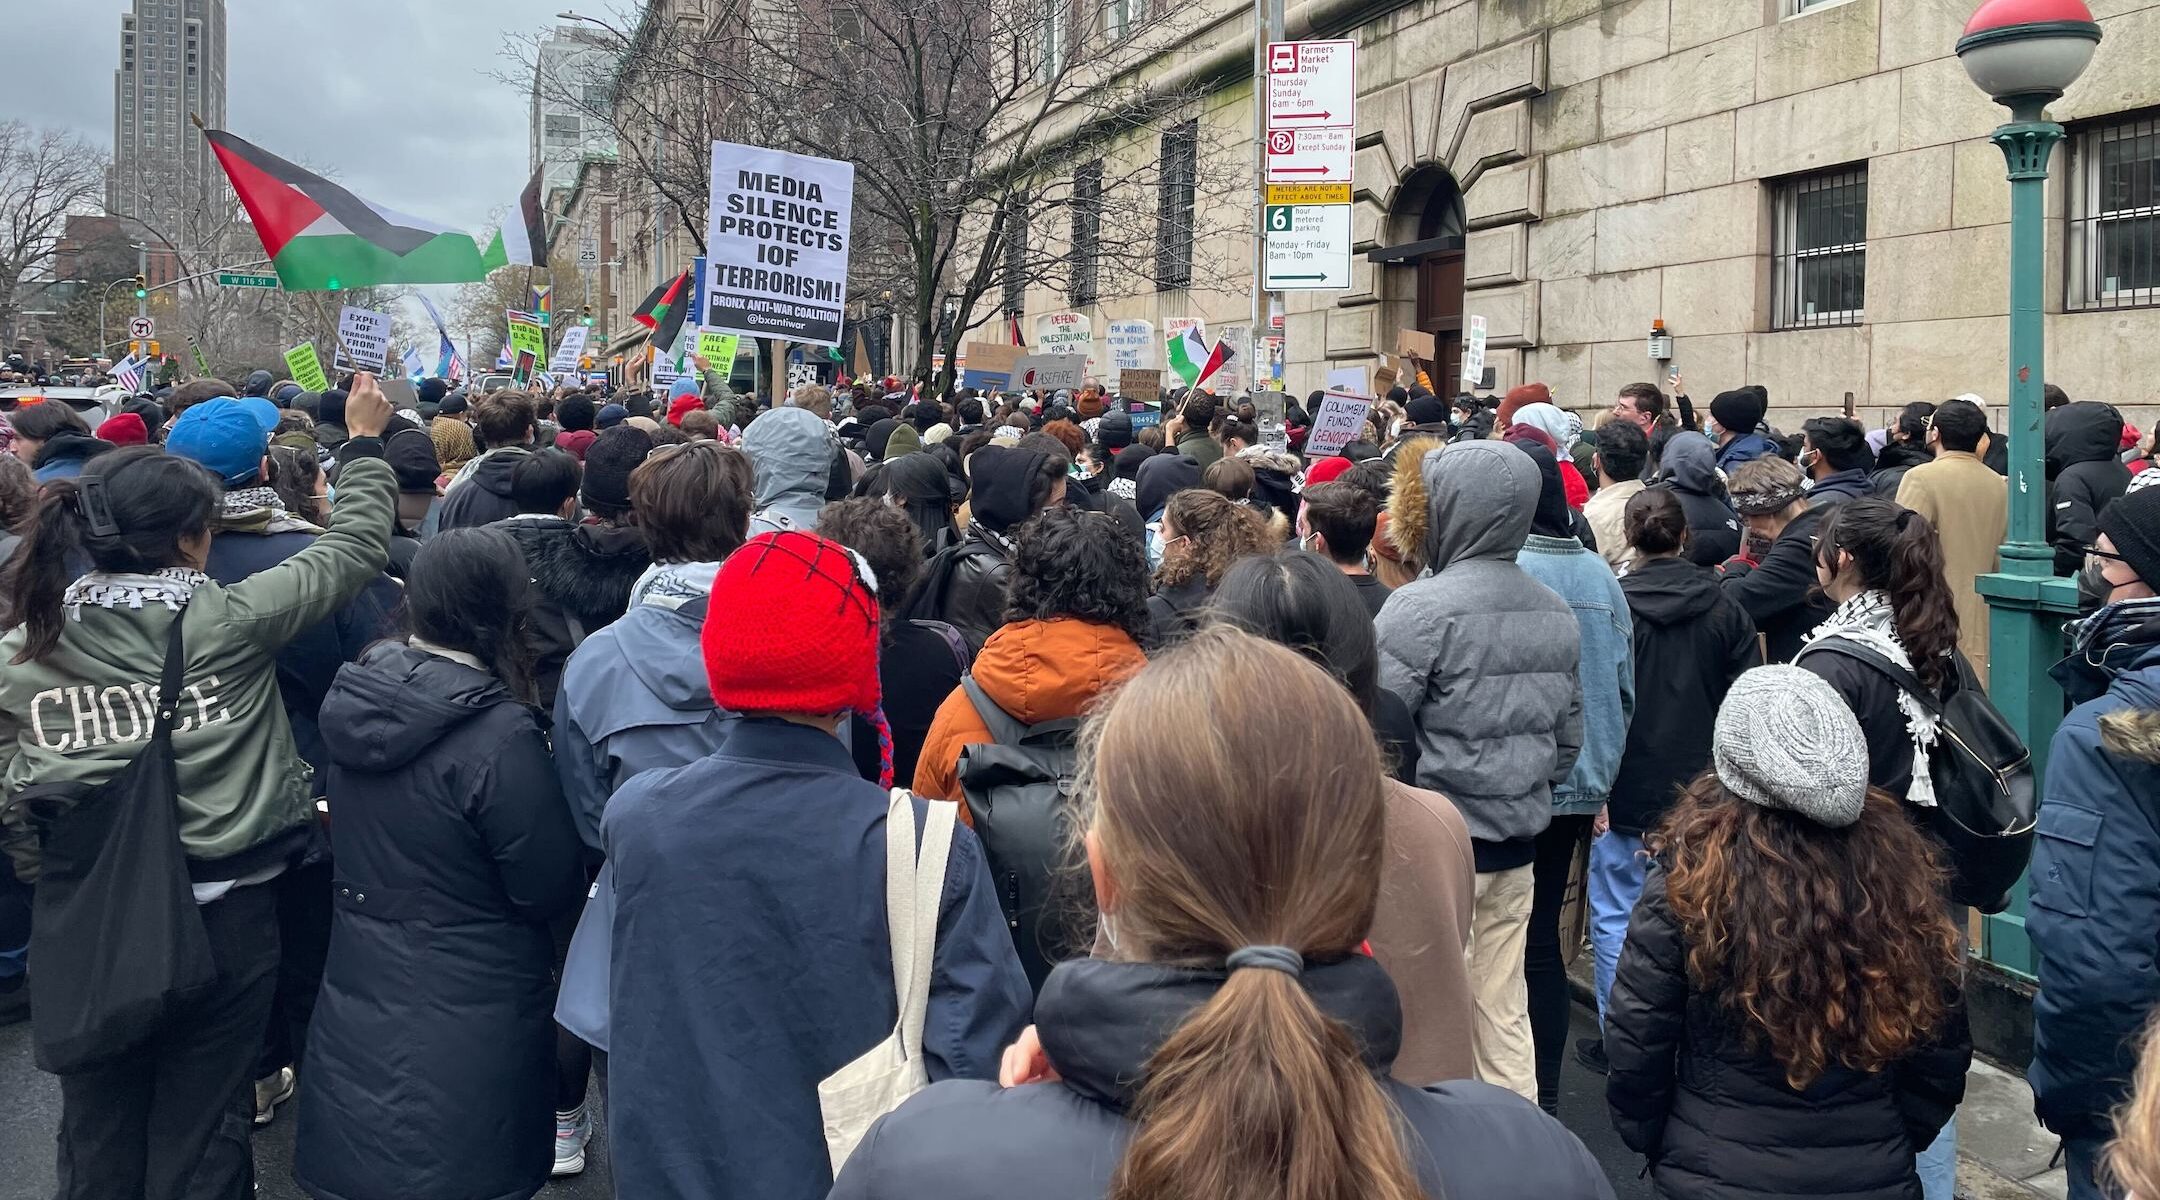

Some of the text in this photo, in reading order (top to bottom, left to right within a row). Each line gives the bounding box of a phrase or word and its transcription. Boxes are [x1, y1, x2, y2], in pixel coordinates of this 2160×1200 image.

[1302, 46, 1334, 54] Farmers
[1302, 55, 1329, 64] Market
[1302, 65, 1319, 74] Only
[1273, 78, 1308, 87] Thursday
[1272, 88, 1301, 97] Sunday
[1297, 99, 1314, 108] 6pm
[1298, 144, 1346, 152] Except Sunday
[738, 170, 823, 203] MEDIA
[727, 193, 838, 230] SILENCE
[1273, 207, 1287, 230] 6
[720, 216, 843, 252] PROTECTS
[1269, 241, 1298, 249] Monday
[1306, 241, 1330, 249] Friday
[581, 251, 596, 260] 25
[757, 244, 799, 268] IOF
[1293, 251, 1313, 260] 10pm
[715, 264, 841, 303] TERRORISM!
[713, 295, 839, 323] BRONX ANTI-WAR COALITION
[350, 314, 379, 326] EXPEL
[747, 313, 806, 330] @bxantiwar
[1051, 315, 1078, 325] DEFEND
[356, 324, 371, 332] IOF
[529, 327, 539, 336] ALL
[341, 330, 386, 343] TERRORISTS
[704, 334, 727, 343] FREE
[1041, 332, 1090, 343] PALESTINIANS!
[346, 338, 375, 349] FROM
[1052, 345, 1066, 354] FOR
[1326, 401, 1365, 416] COLUMBIA
[1326, 416, 1354, 427] FUNDS
[1314, 429, 1358, 444] GENOCIDE
